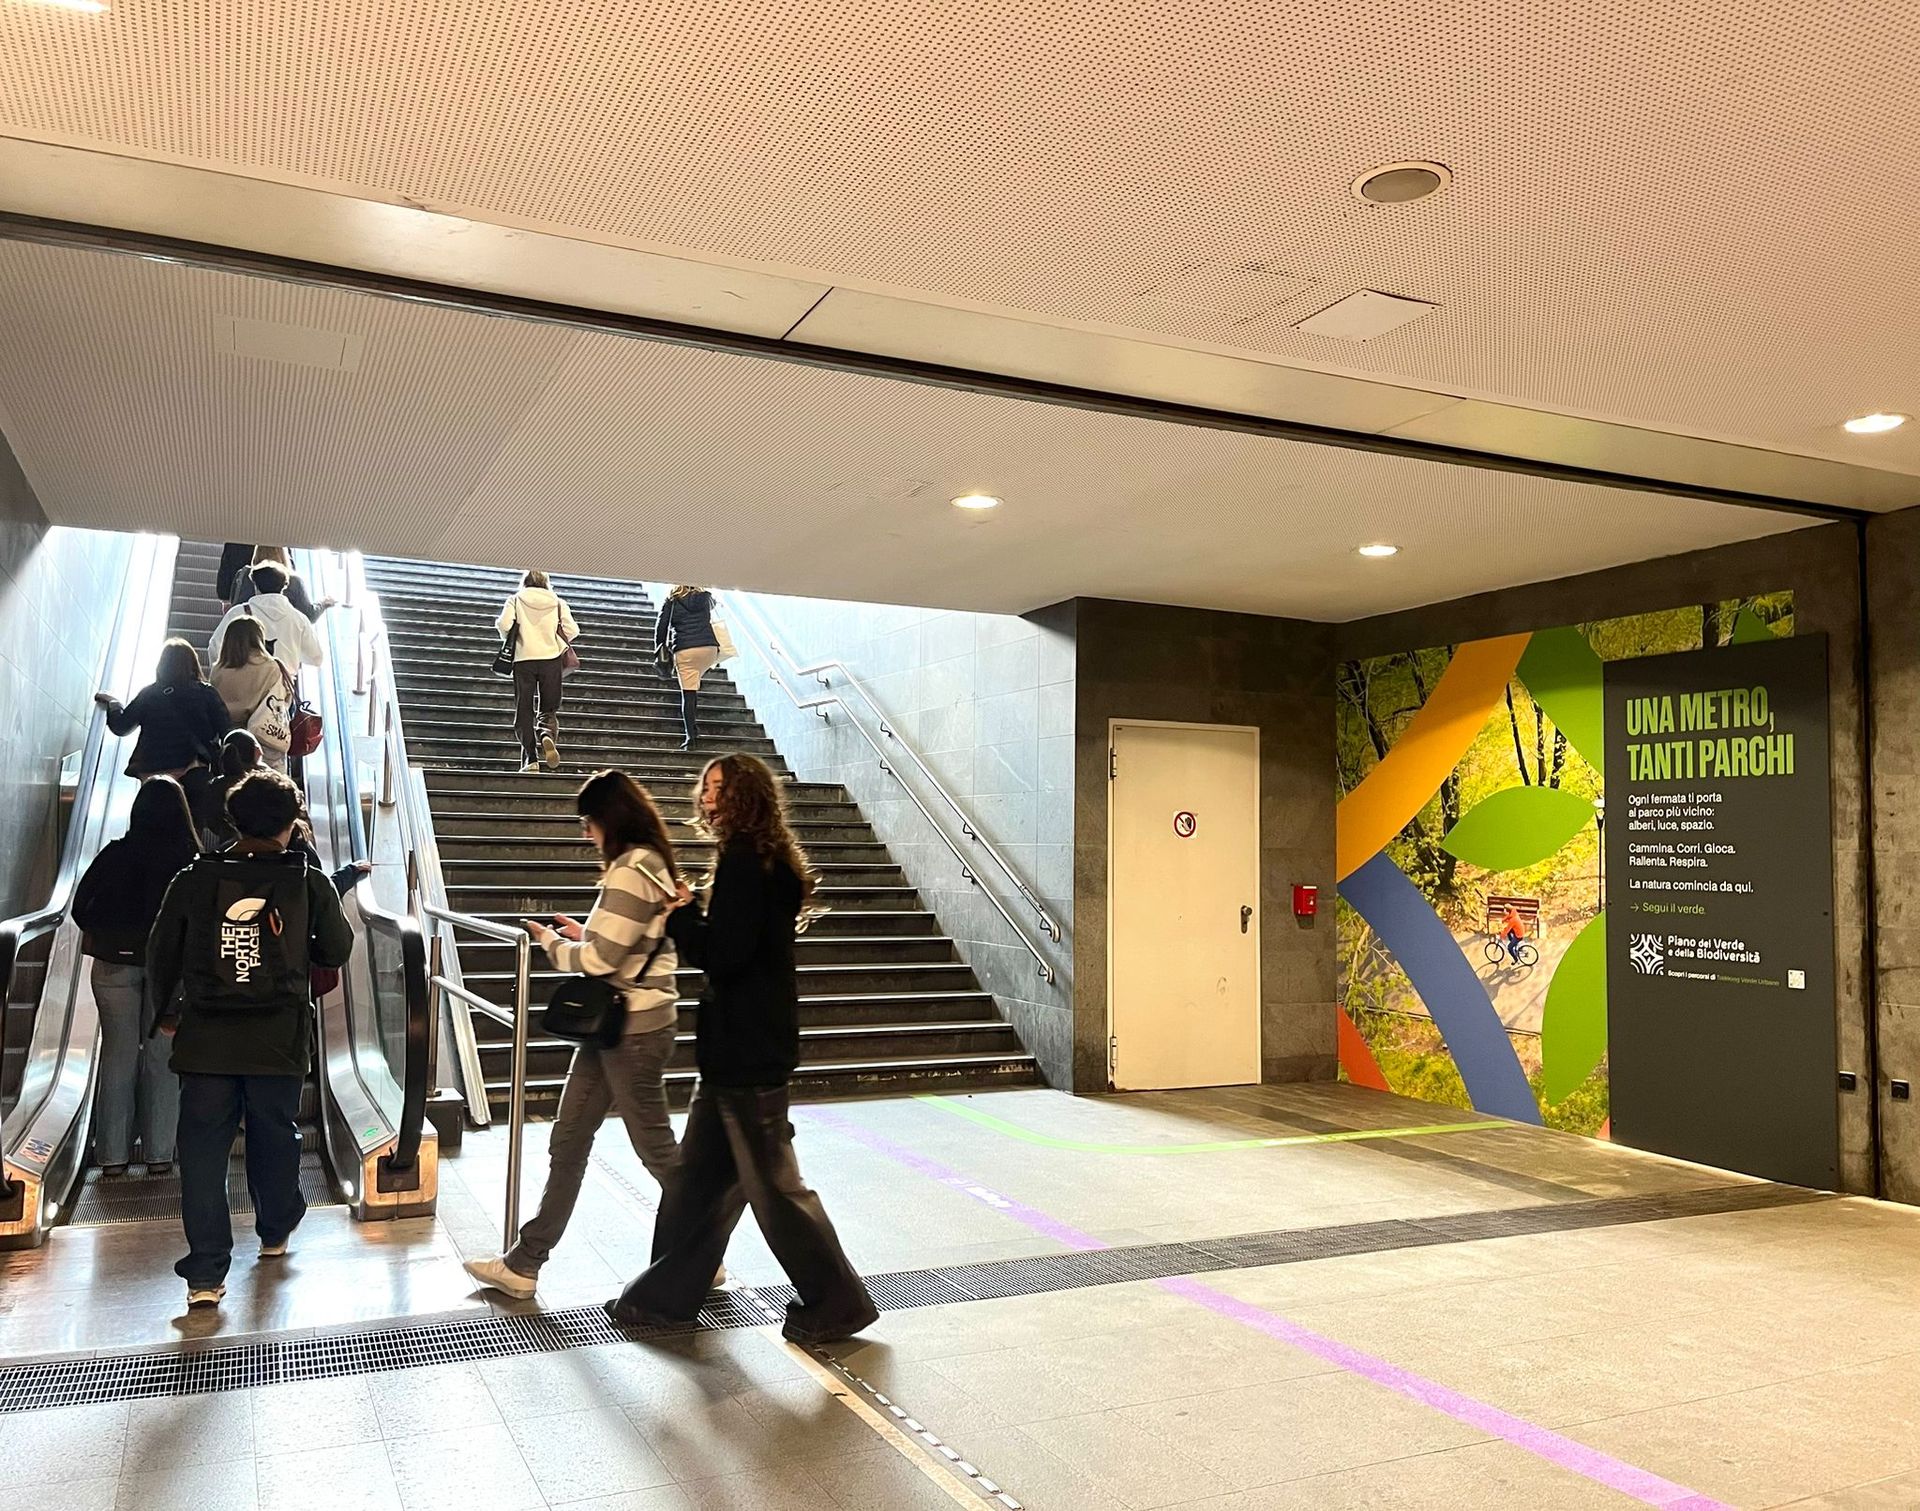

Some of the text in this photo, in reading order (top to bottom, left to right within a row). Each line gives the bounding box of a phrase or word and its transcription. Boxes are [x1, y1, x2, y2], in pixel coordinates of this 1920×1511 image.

[1626, 686, 1774, 736] UNA METRO,
[1626, 734, 1794, 781] TANTI PARCHI
[1628, 792, 1722, 806] Ogni fermata ti porta
[1628, 806, 1715, 818] al parco più vicino:
[1628, 819, 1715, 832] alberi, luce, spazio.
[1628, 842, 1736, 854] Cammina. Corri. Gioca.
[1629, 856, 1708, 868] Rallenta. Respira.
[1629, 878, 1754, 894] La natura comincia da qui.
[1642, 902, 1668, 914] Segui
[1670, 902, 1676, 913] il
[220, 926, 236, 958] THE
[250, 926, 262, 968] FACE
[1668, 935, 1744, 950] Piano del Verde
[236, 926, 250, 982] NORTH
[1674, 948, 1694, 958] della
[1696, 949, 1760, 964] Biodiversità
[1668, 970, 1685, 978] Scopri
[1688, 972, 1710, 980] percorsi
